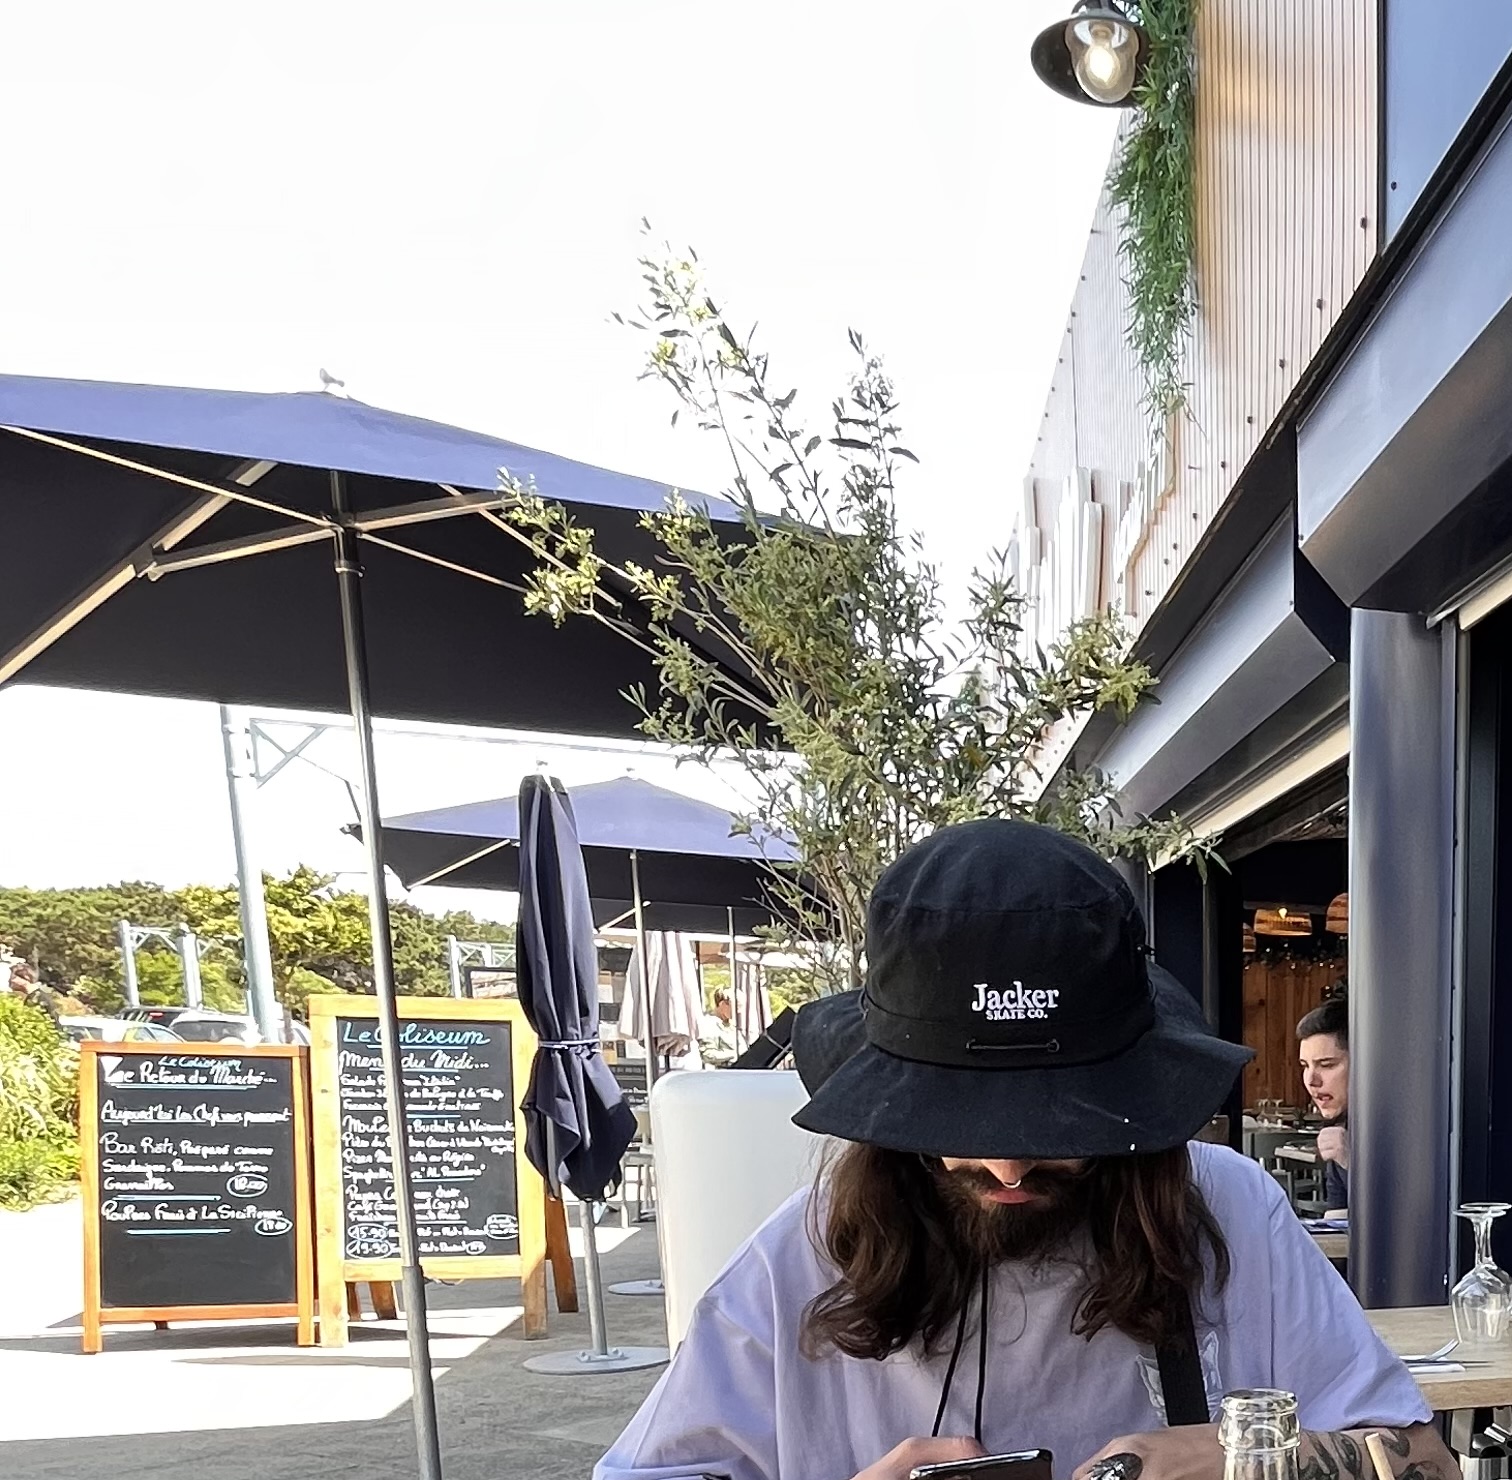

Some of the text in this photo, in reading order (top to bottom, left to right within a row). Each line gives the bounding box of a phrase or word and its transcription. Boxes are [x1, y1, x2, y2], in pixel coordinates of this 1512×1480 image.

[971, 981, 1060, 1011] Jacker
[985, 1009, 1048, 1020] SKATE CO.
[343, 1021, 491, 1044] Le Cliseum
[339, 1050, 384, 1074] Men
[402, 1053, 425, 1069] du
